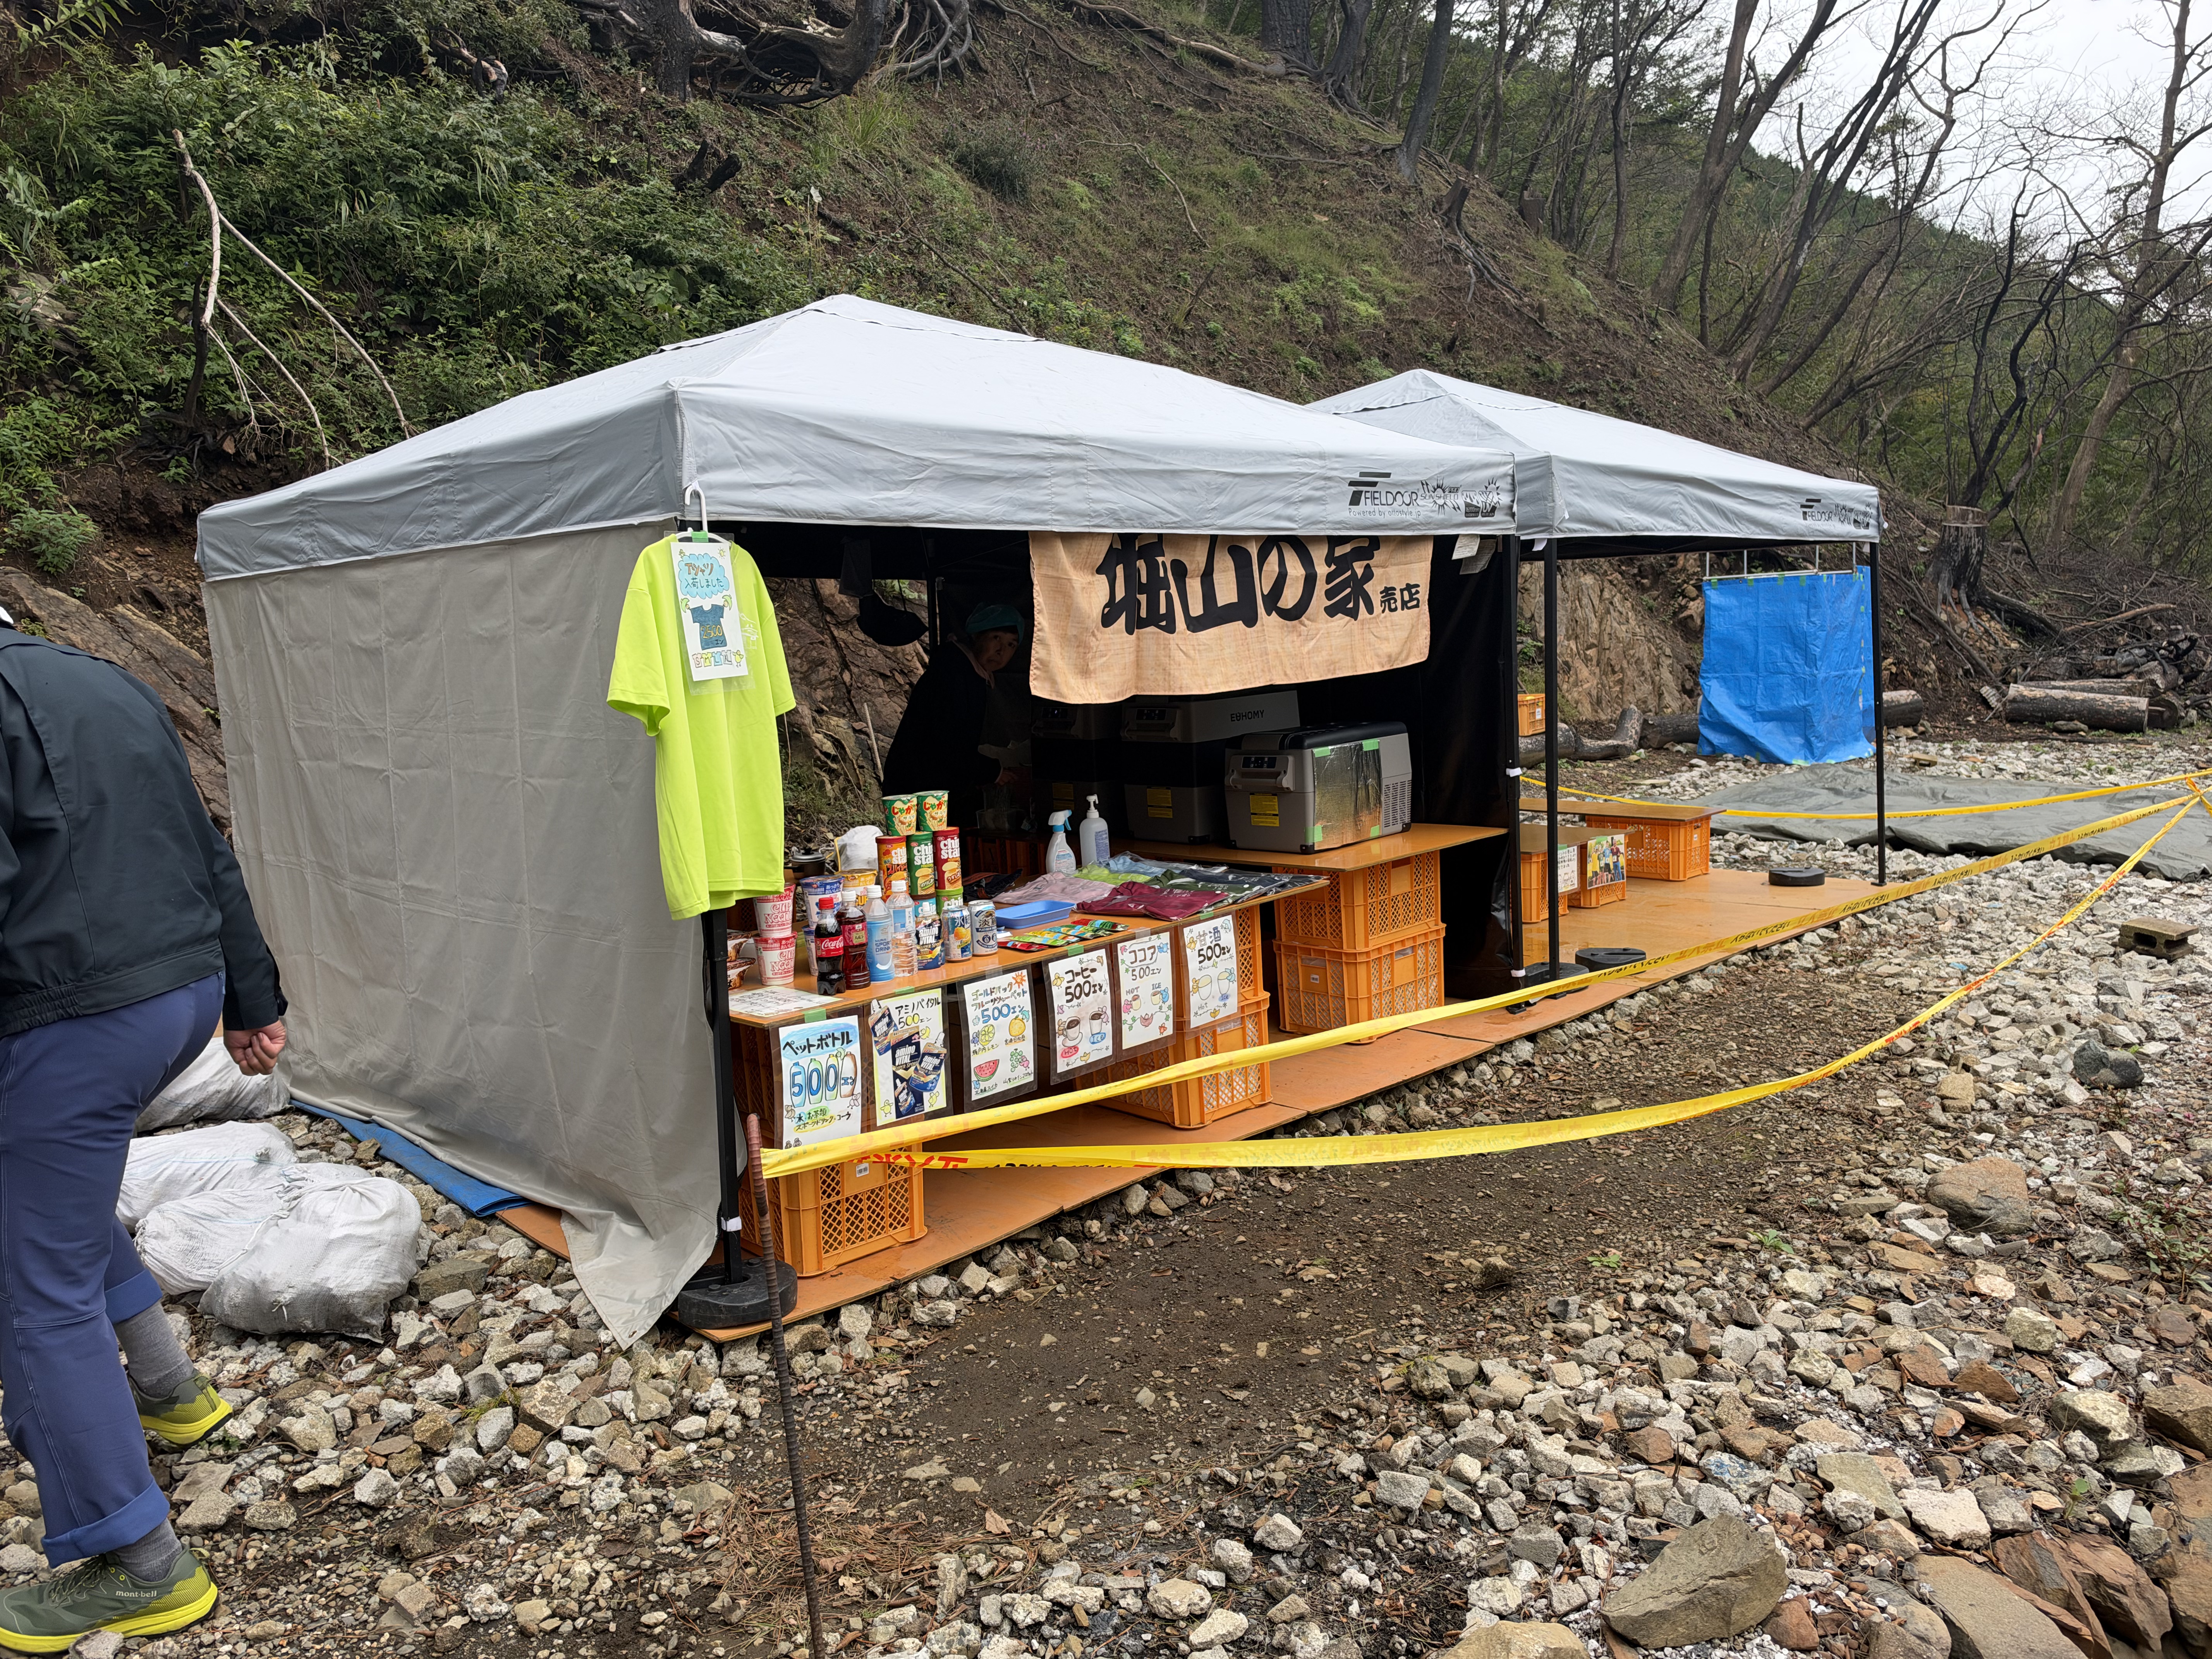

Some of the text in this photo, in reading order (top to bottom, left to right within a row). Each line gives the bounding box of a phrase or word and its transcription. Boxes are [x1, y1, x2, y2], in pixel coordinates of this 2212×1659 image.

[1364, 490, 1419, 507] FIELDOOR
[1349, 508, 1421, 519] Powered by ottostyle.jp
[685, 563, 713, 576] Tシャツ
[685, 577, 724, 589] 入荷しました
[1379, 582, 1421, 613] 売店
[701, 625, 722, 639] 2500
[696, 657, 700, 665] S
[1230, 709, 1265, 722] EUHOMY
[1839, 893, 1889, 915] 入らないでください
[919, 926, 939, 937] amino
[1196, 926, 1221, 947] 甘酒
[1731, 921, 1790, 944] 入らないでください
[920, 934, 936, 946] VITAL
[1129, 945, 1156, 964] ココア
[1065, 967, 1097, 984] コーヒー
[1126, 986, 1140, 996] HOT
[895, 997, 941, 1017] アミノバイタル
[1198, 1002, 1208, 1011] Hot
[874, 1015, 889, 1032] amino
[783, 1031, 853, 1055] ペットボトル
[895, 1044, 916, 1058] amino
[896, 1054, 911, 1066] VITAL
[920, 1061, 935, 1071] VITAL
[923, 1054, 941, 1065] amino
